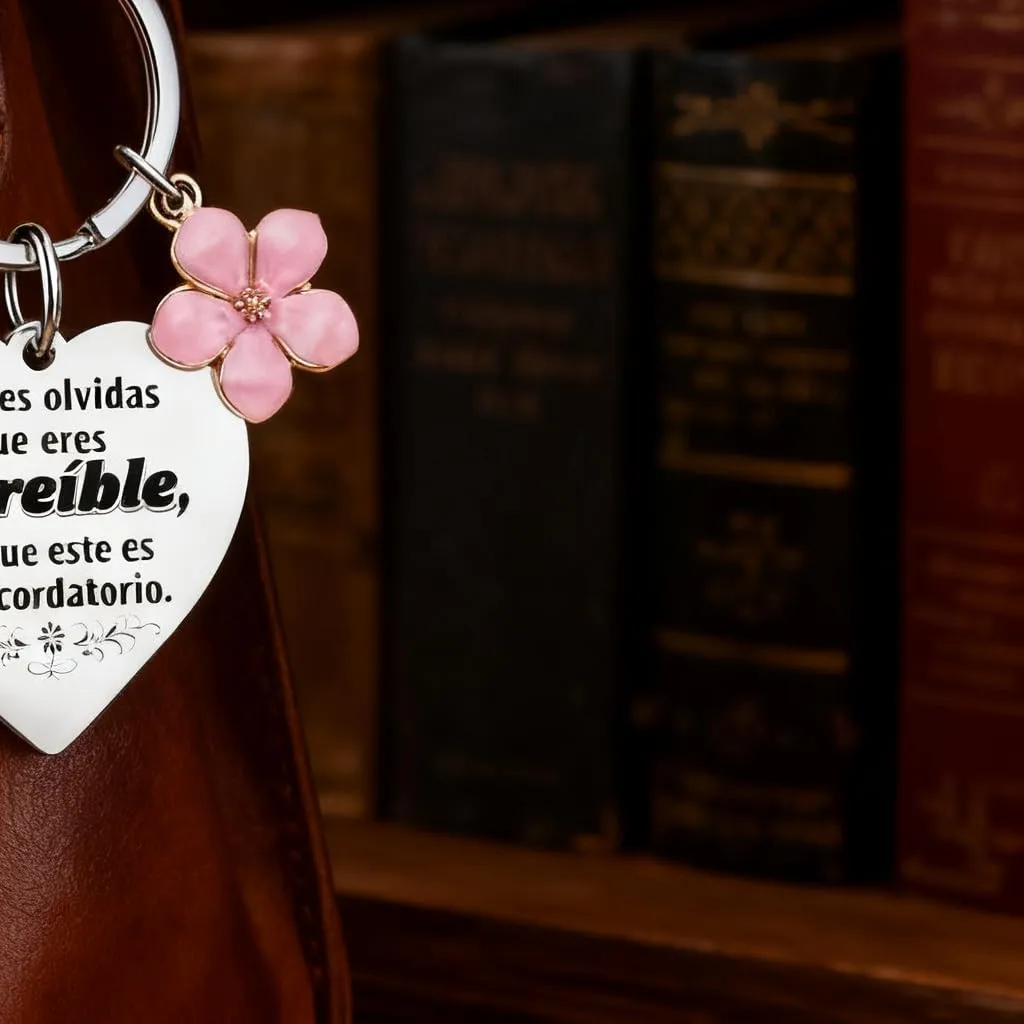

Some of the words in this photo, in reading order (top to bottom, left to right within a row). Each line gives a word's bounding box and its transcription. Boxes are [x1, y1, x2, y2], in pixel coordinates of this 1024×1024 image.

[43, 376, 160, 411] olvidas
[41, 430, 107, 455] eres
[48, 538, 112, 565] este
[121, 538, 155, 563] es
